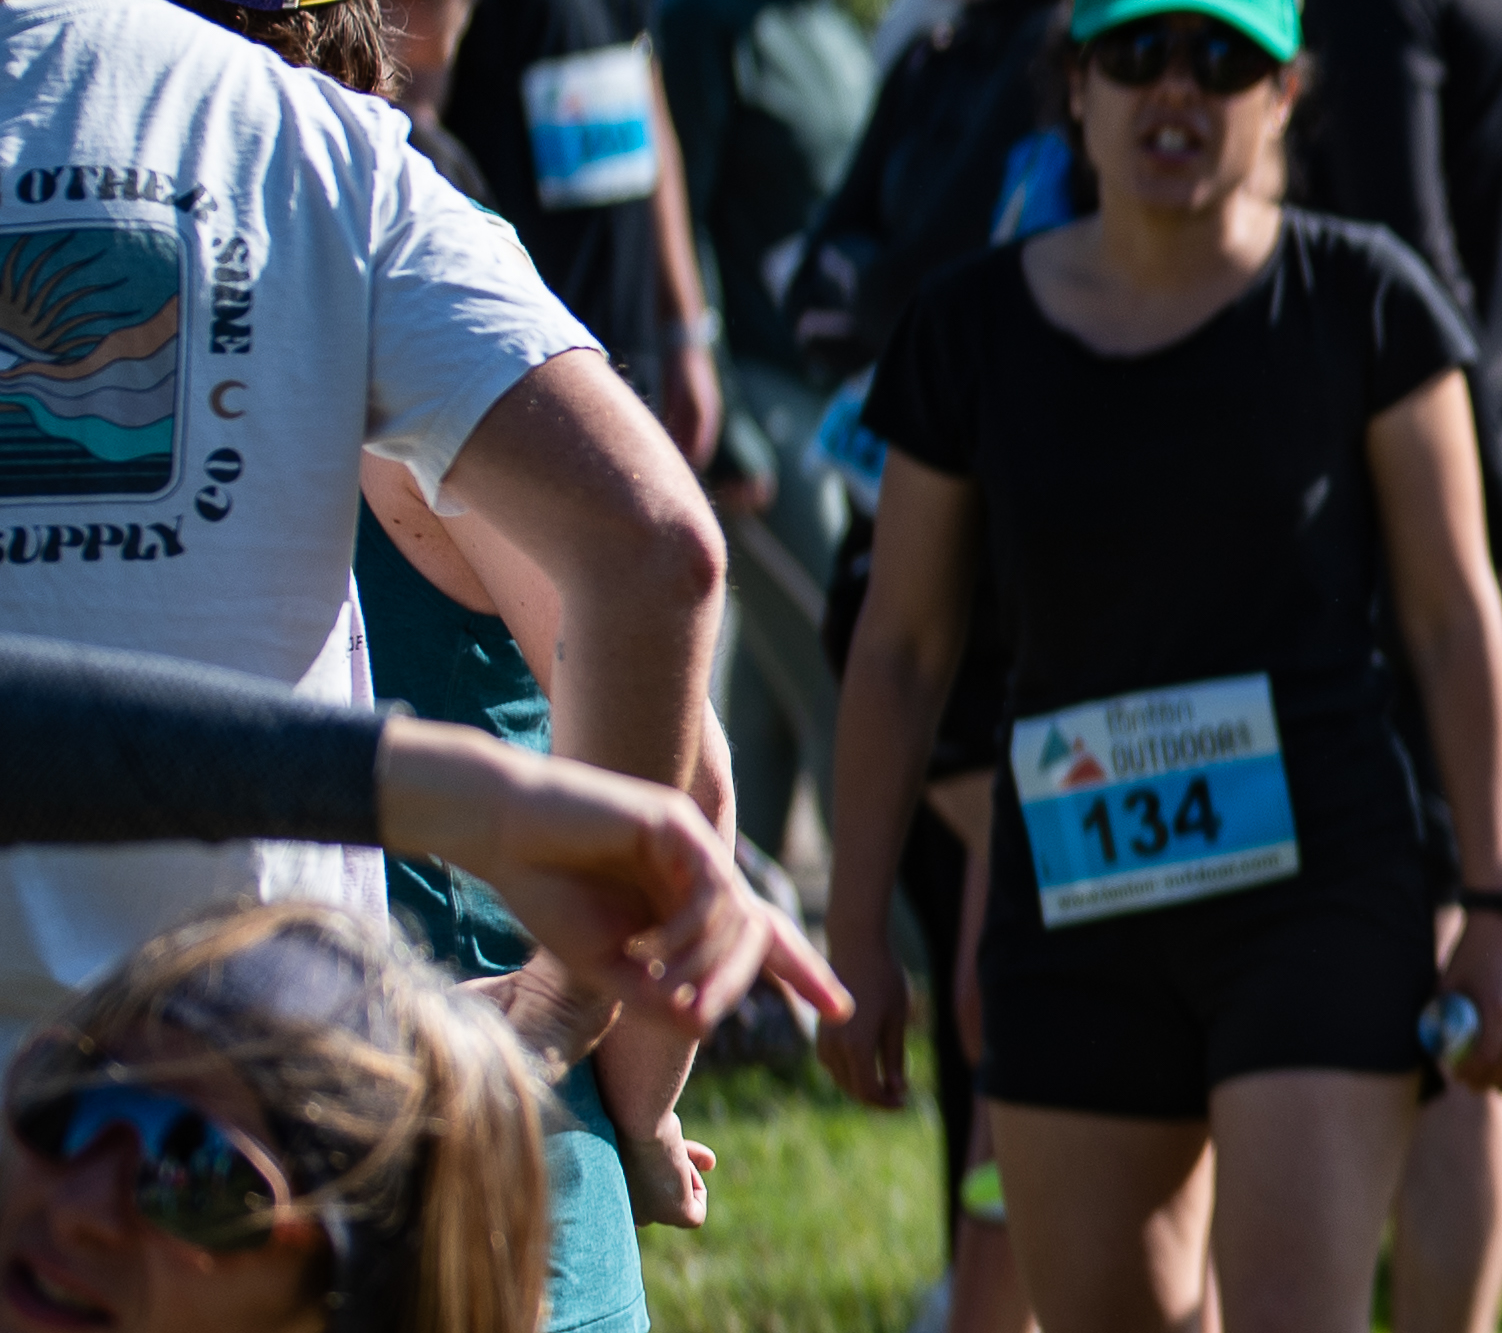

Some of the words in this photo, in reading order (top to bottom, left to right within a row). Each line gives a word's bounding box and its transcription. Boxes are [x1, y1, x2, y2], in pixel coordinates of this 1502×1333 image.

[16, 165, 218, 221] OTHER
[210, 235, 252, 355] SIDE
[0, 514, 185, 564] UPPLY
[1082, 773, 1223, 866] 134
